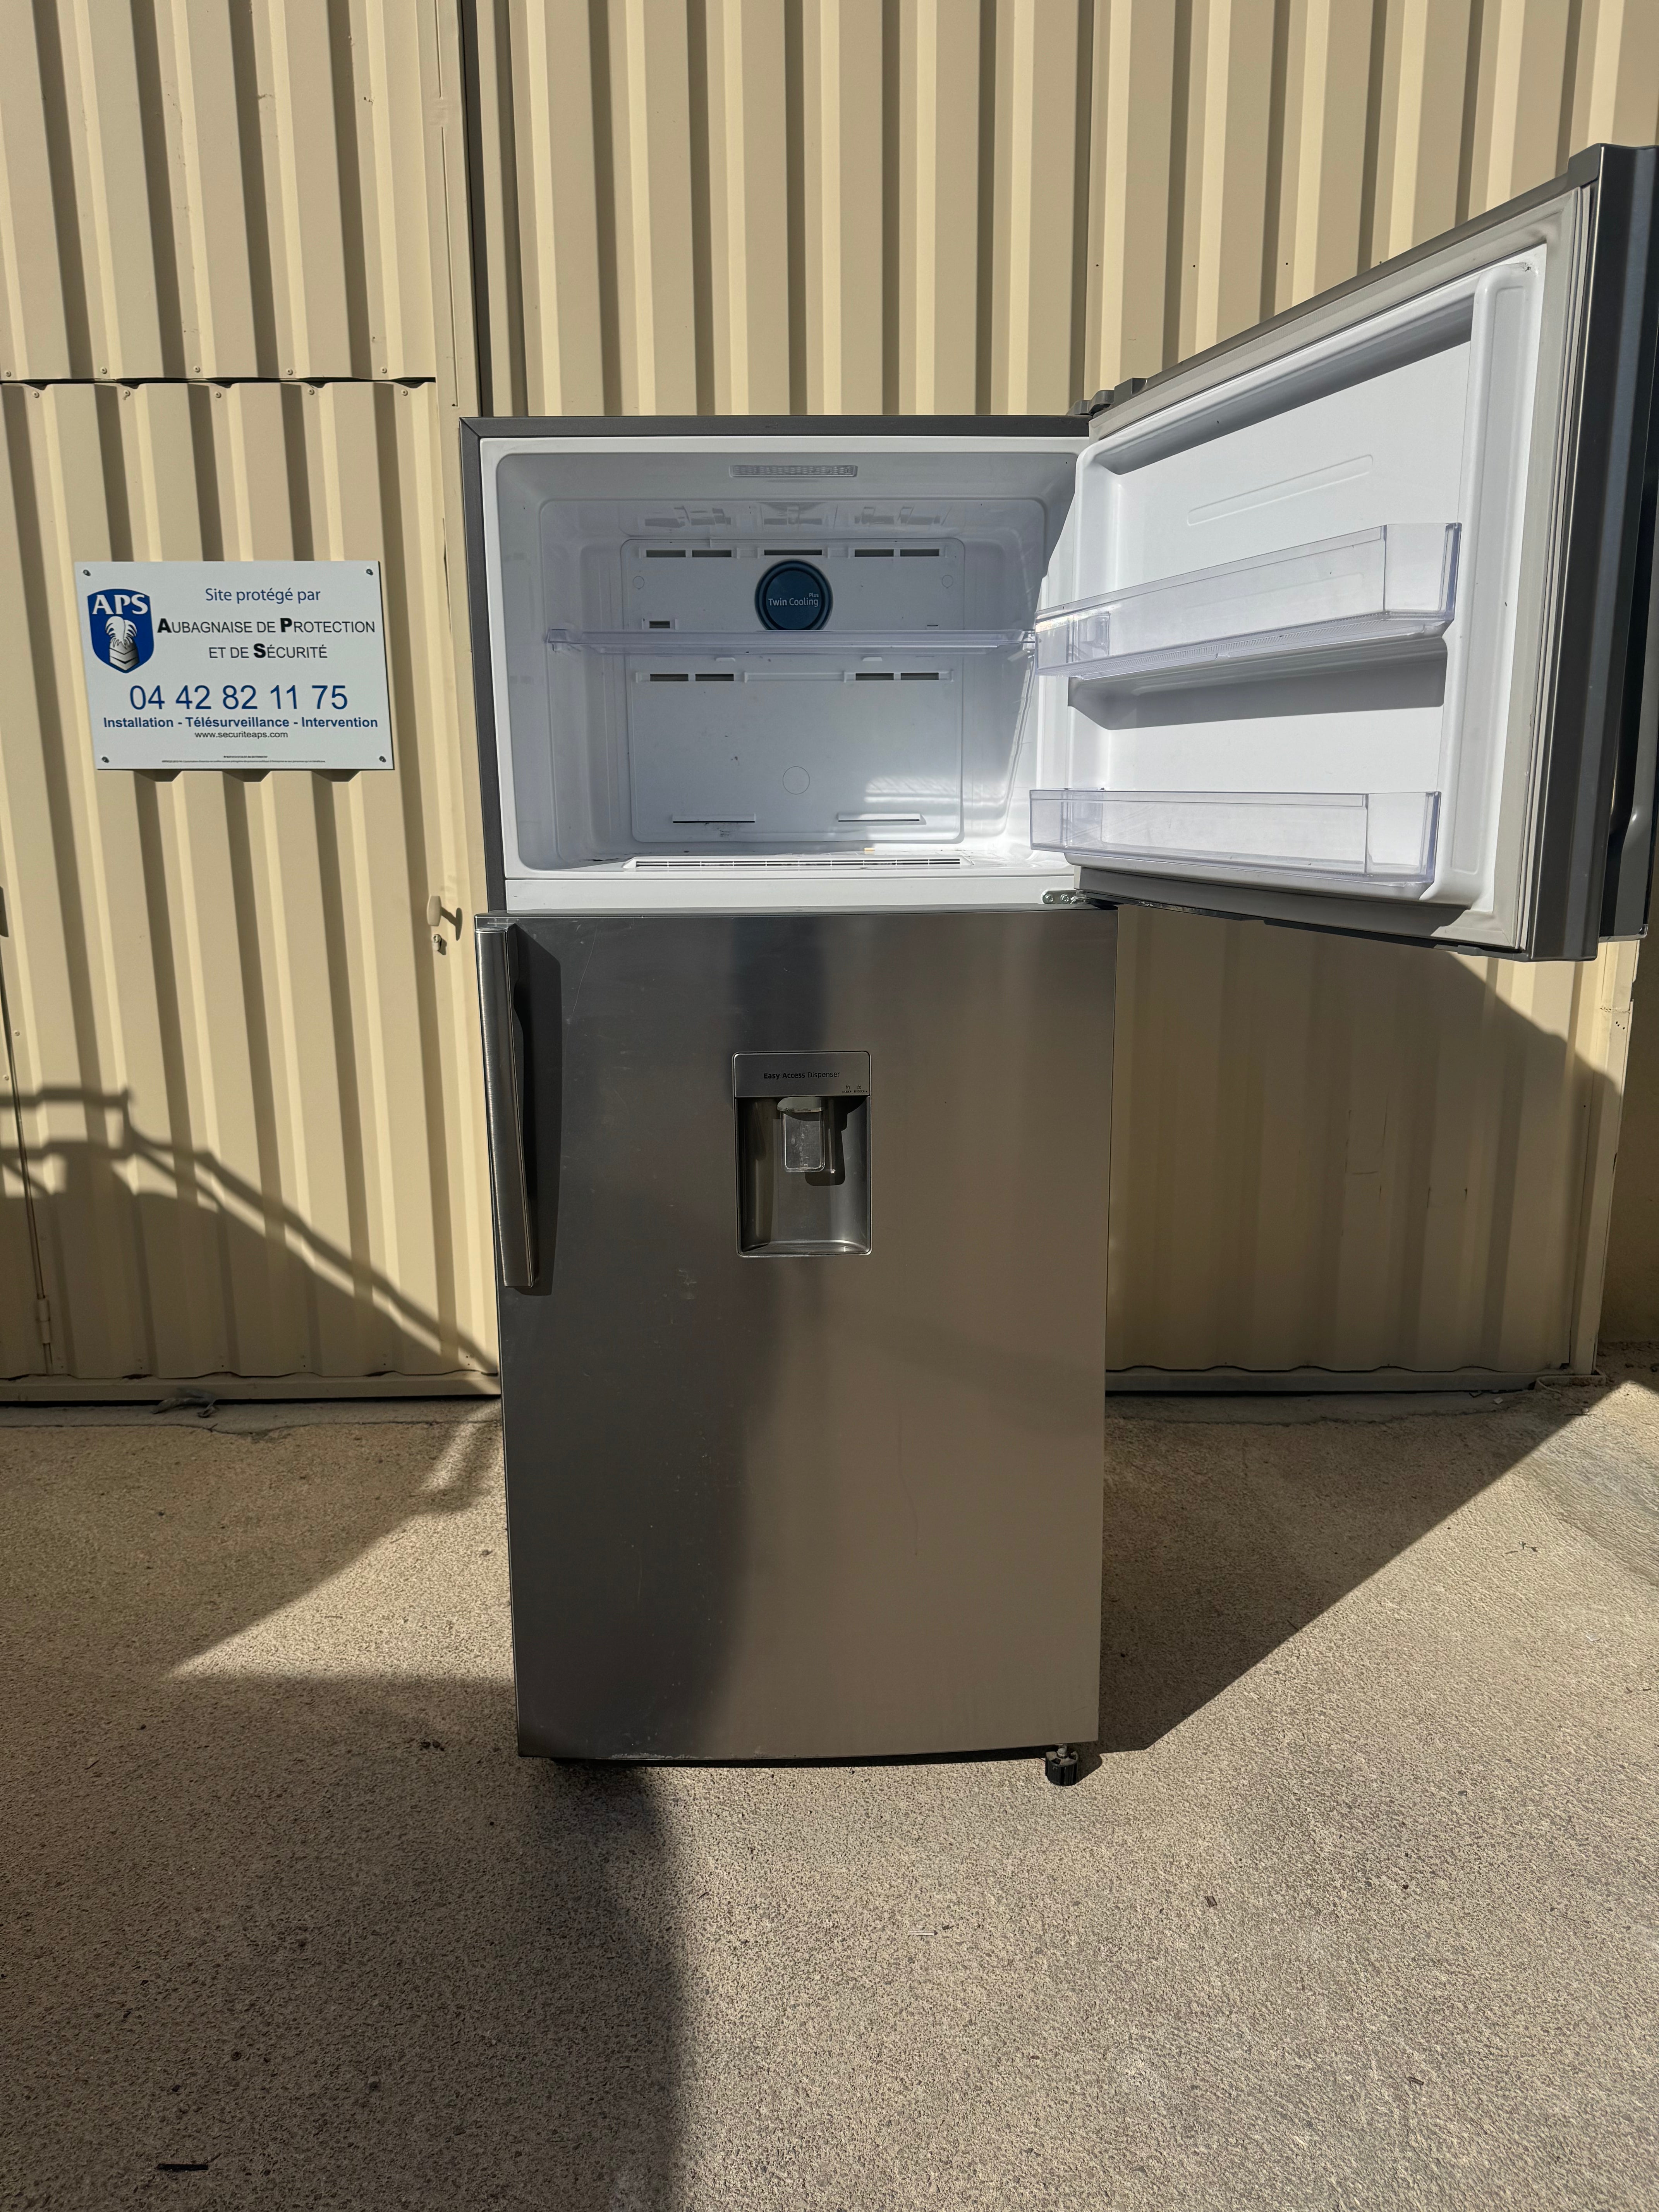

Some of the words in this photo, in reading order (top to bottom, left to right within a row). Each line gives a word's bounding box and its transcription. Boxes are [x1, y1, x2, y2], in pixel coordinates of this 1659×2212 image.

[205, 588, 232, 601] Site
[236, 587, 293, 604] protégé
[297, 591, 321, 604] par
[789, 597, 818, 607] Cooling
[92, 594, 148, 615] APS
[157, 618, 253, 633] AUBAGNAISE
[257, 621, 276, 633] DE
[280, 618, 375, 633] PROTECTION
[209, 647, 226, 658] ET
[230, 647, 249, 658] DE
[253, 643, 328, 658] SÉCURITÉ
[130, 685, 165, 710] 04
[175, 685, 211, 709] 42
[223, 685, 258, 710] 82
[270, 685, 297, 709] 11
[312, 685, 348, 710] 75
[103, 717, 174, 728] Installation
[185, 716, 289, 727] Télésurveillance
[302, 717, 378, 727] Intervention
[194, 731, 288, 739] www.securiteaps.com
